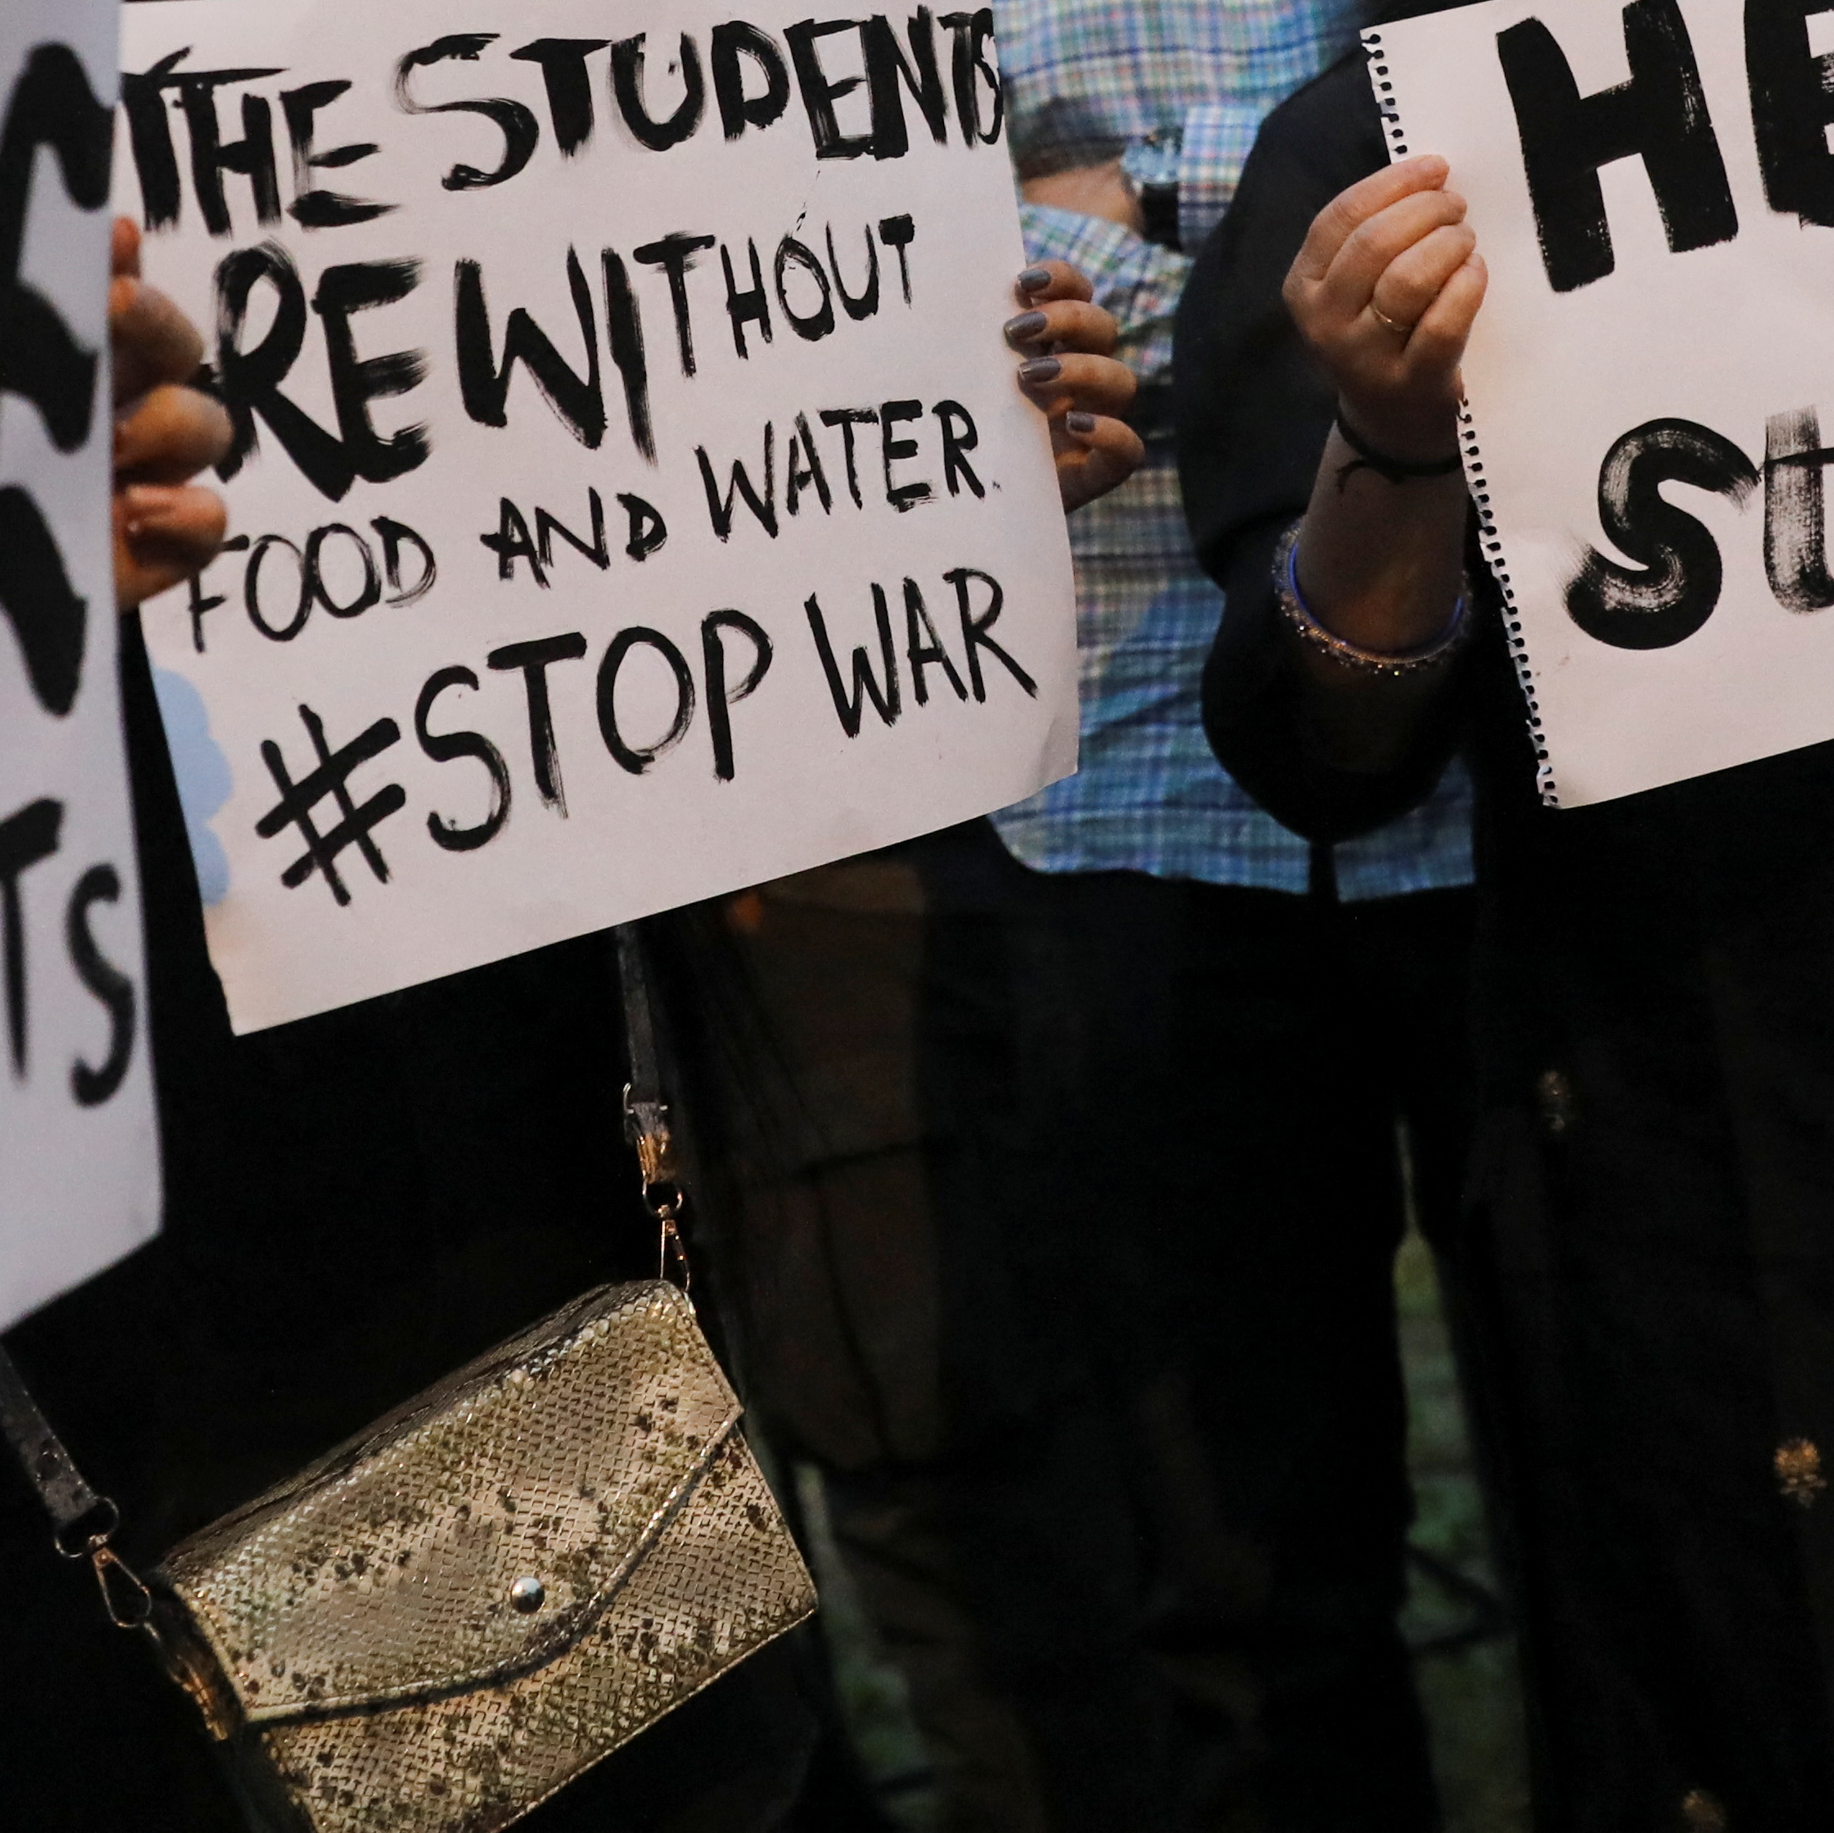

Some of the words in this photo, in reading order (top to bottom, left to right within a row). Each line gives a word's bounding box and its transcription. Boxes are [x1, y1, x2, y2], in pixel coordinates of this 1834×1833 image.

[122, 45, 400, 239] THE
[200, 232, 435, 503] RE
[454, 210, 915, 466] WITHOUT
[187, 515, 437, 654] FOOD
[480, 486, 668, 590] AND
[691, 398, 987, 543] WATER
[254, 609, 775, 906] #STOP
[803, 568, 1038, 739] WAR
